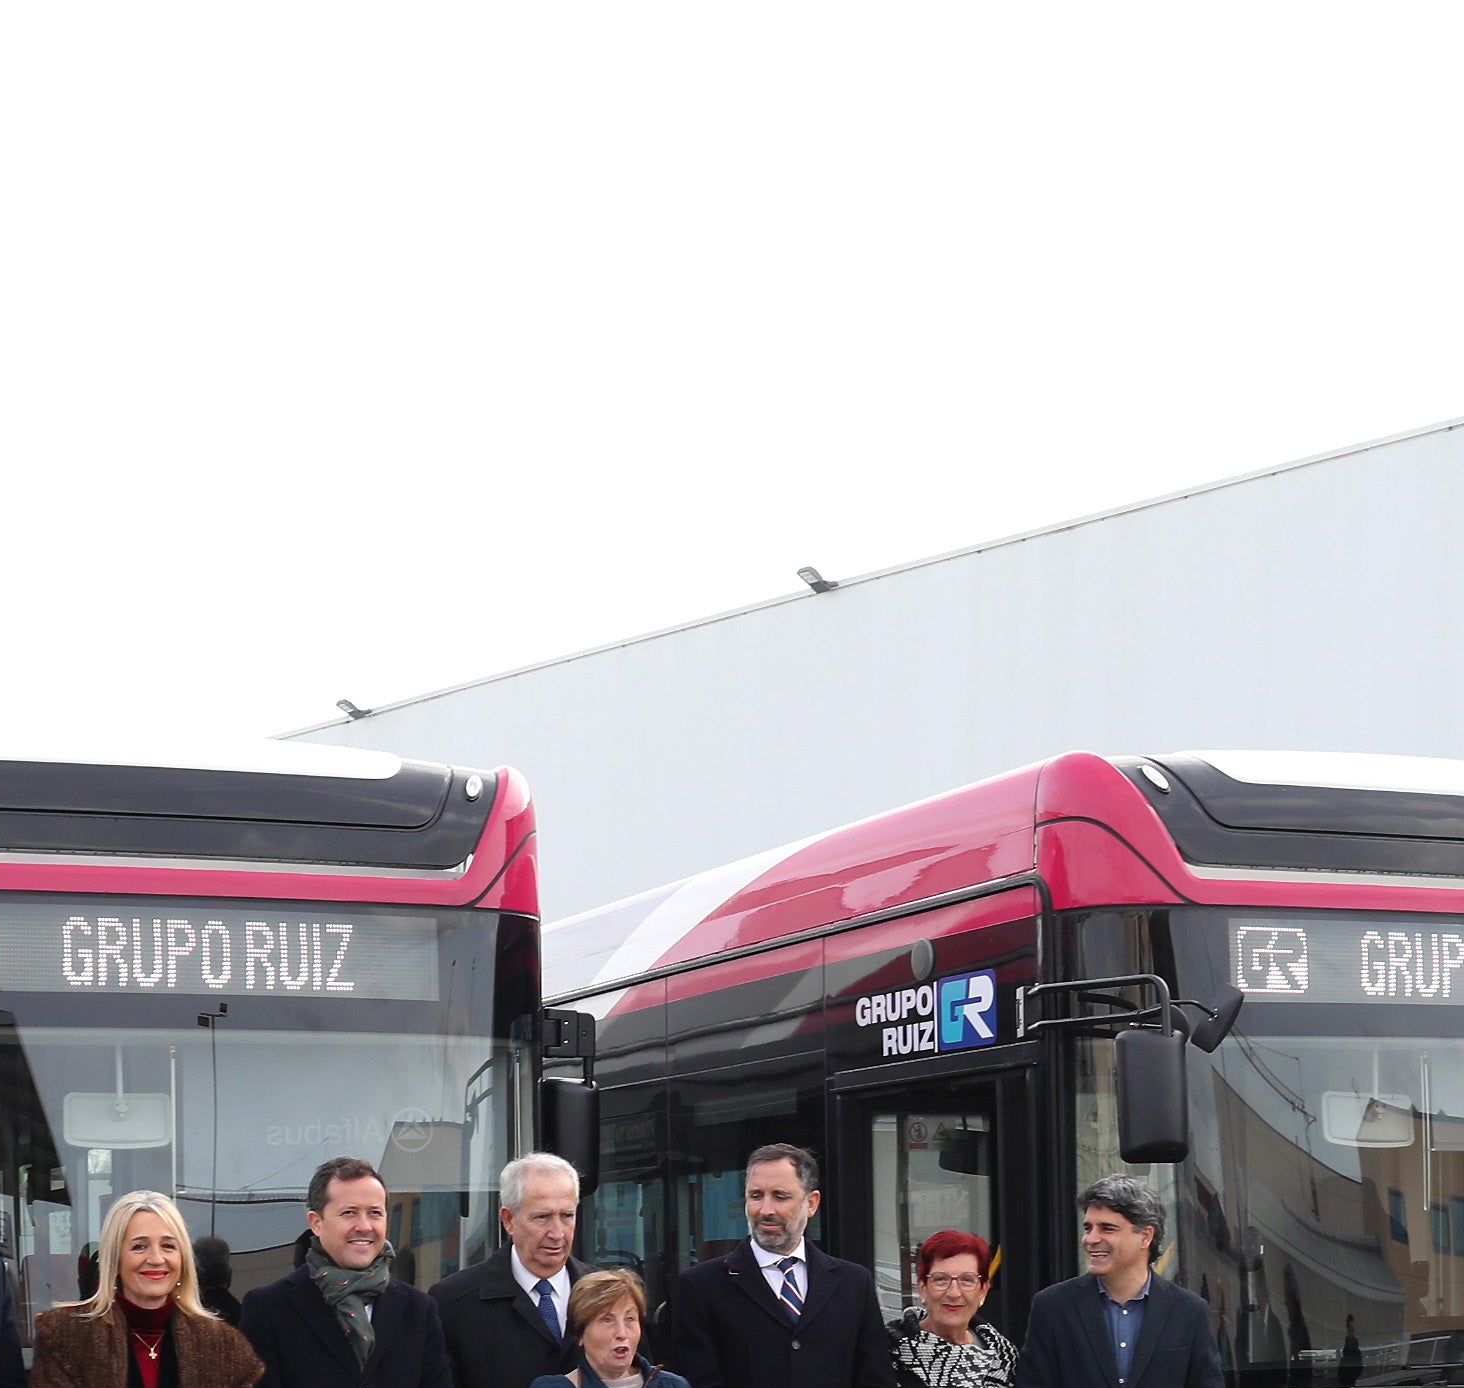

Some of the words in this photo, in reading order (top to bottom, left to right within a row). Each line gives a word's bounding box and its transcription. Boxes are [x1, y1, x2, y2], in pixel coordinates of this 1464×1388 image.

[62, 916, 231, 989] GRUPO
[244, 921, 355, 991] RUIZ
[855, 985, 934, 1027] GRUPO
[941, 975, 995, 1044] GR
[882, 1020, 935, 1057] RUIZ
